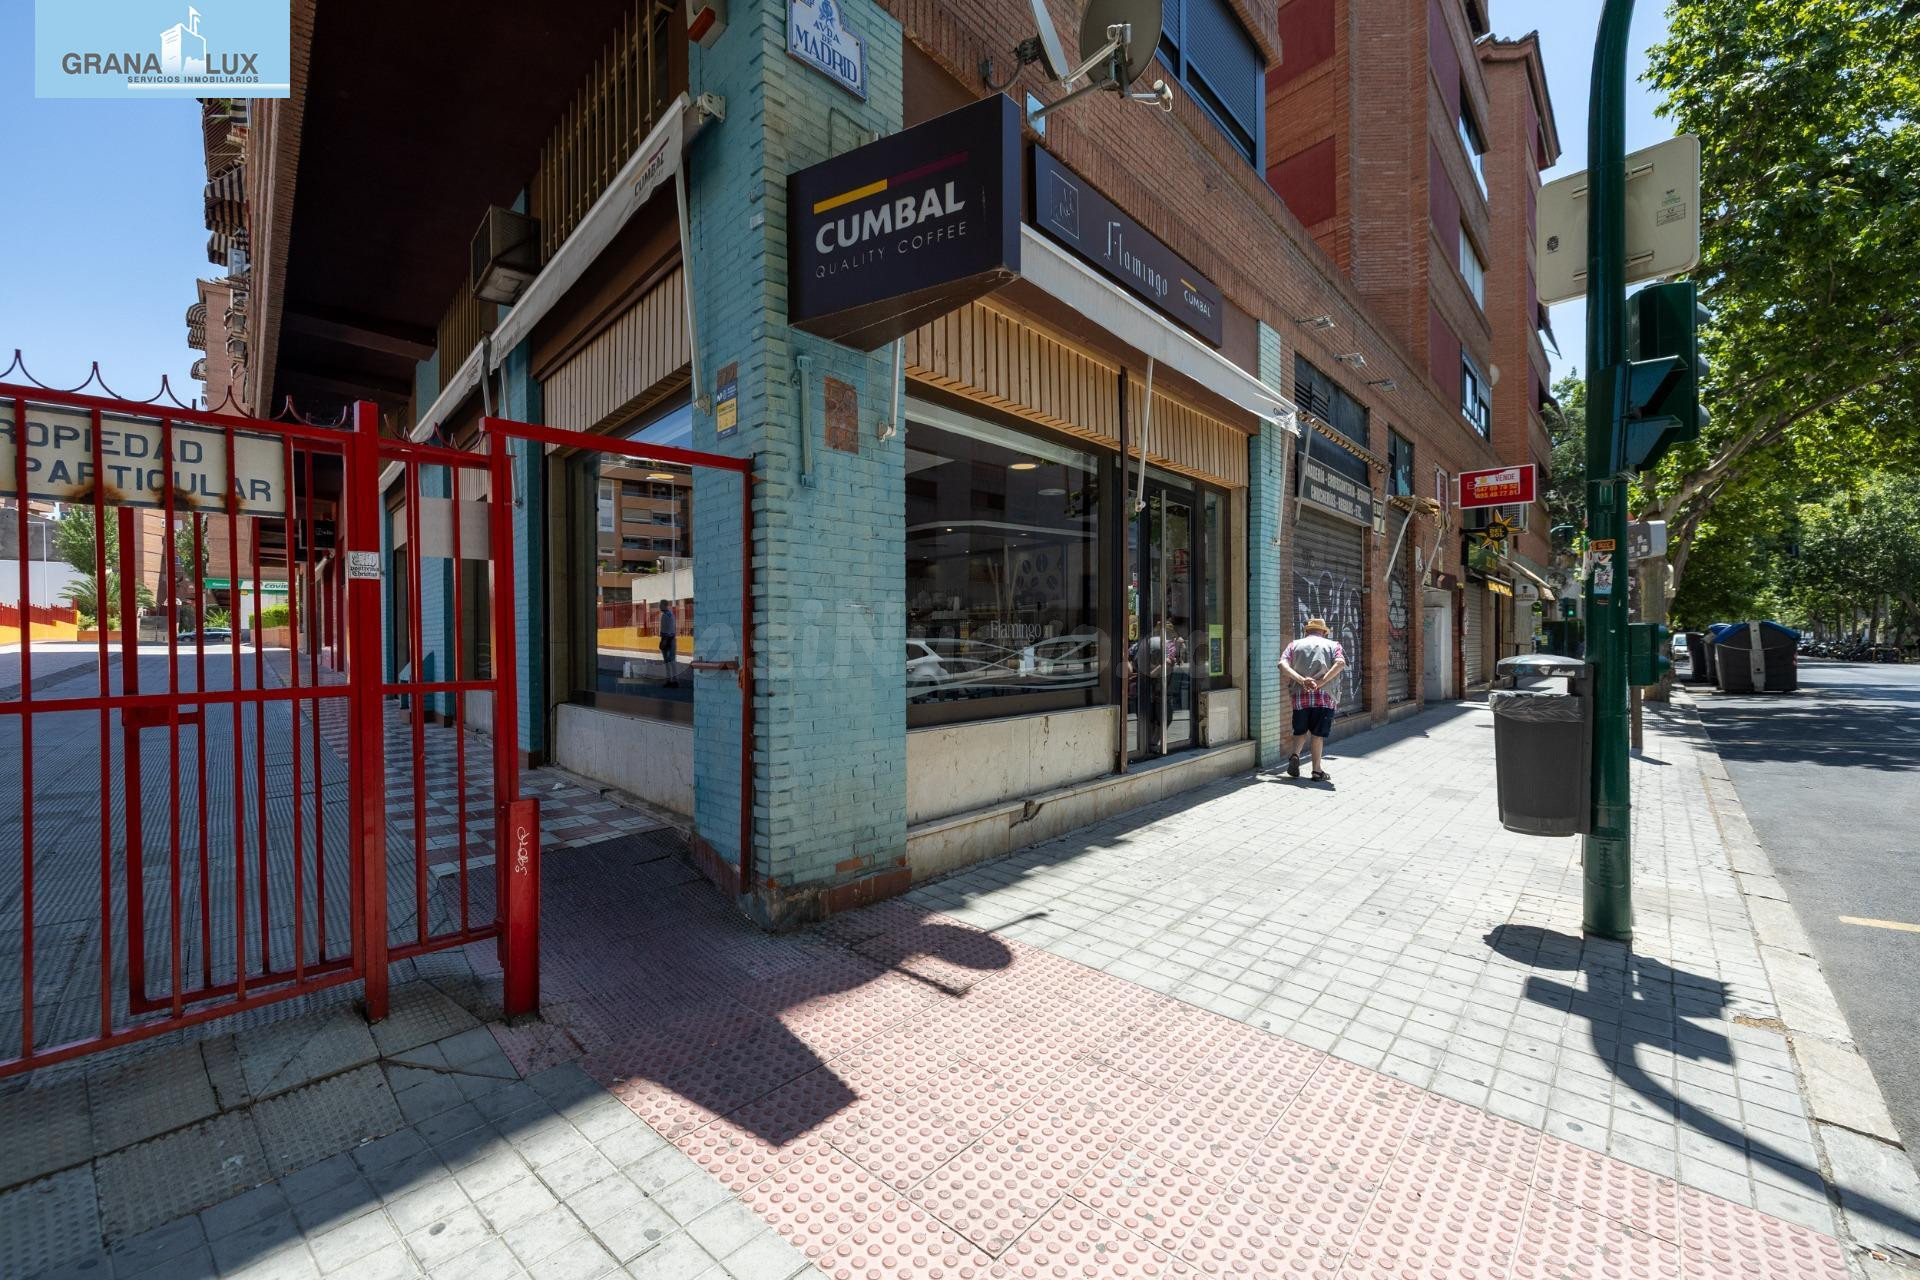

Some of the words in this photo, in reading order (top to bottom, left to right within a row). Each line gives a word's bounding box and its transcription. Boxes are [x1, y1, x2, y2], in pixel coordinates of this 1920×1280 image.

[795, 24, 857, 83] MADRID
[815, 181, 966, 255] CUMBAL
[815, 247, 886, 279] QUALITY
[897, 221, 968, 255] COFFEE
[1104, 221, 1169, 297] Flamingo
[1184, 289, 1211, 319] CUMBAL
[15, 455, 272, 502] PARTICULAR
[990, 619, 1041, 642] Flamingo
